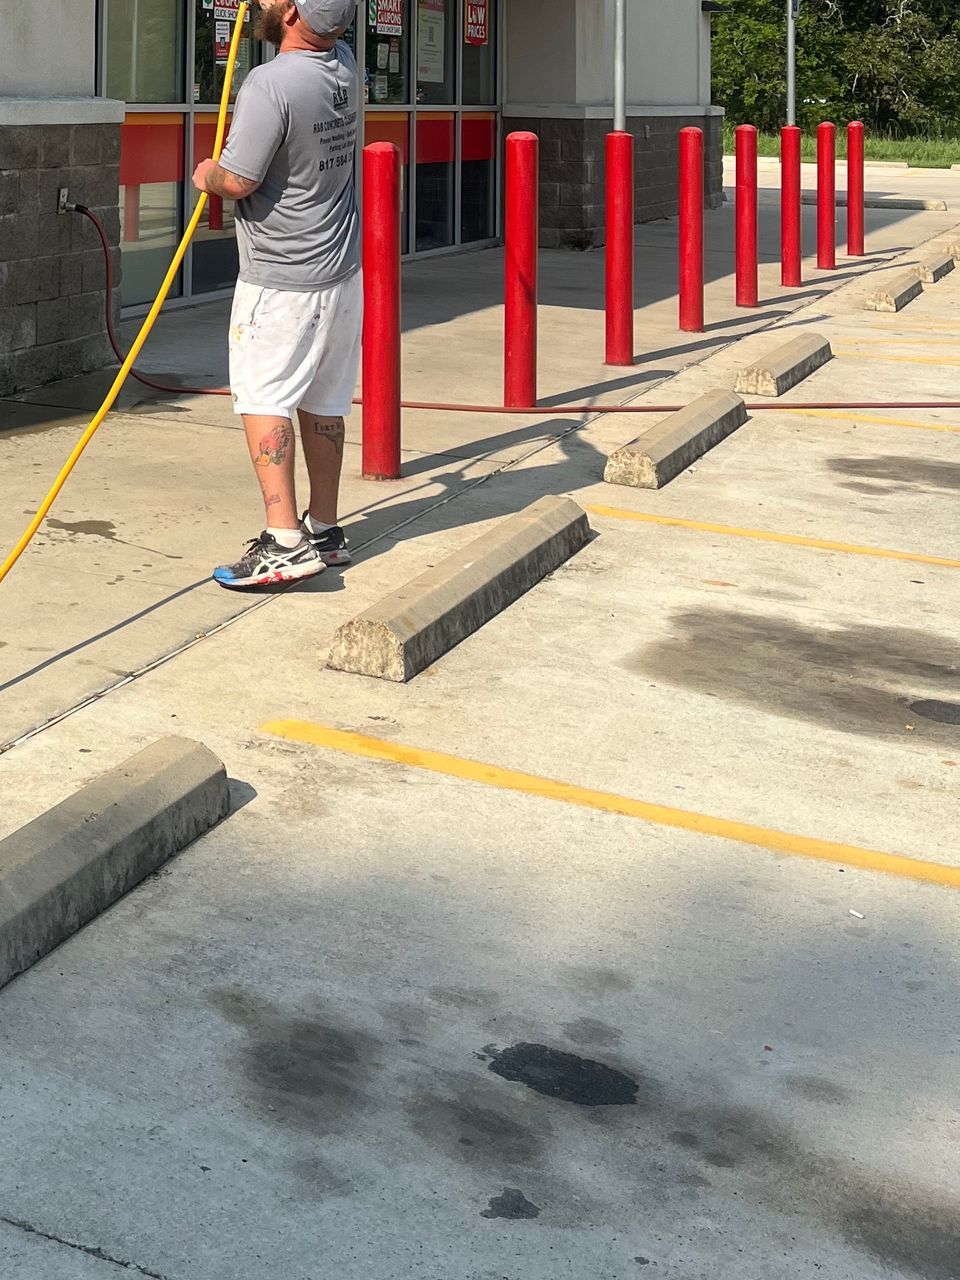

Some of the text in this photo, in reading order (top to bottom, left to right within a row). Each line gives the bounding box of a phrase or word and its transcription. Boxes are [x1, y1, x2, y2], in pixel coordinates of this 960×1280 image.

[378, 11, 402, 25] COUPONS
[468, 5, 485, 25] LOW
[468, 25, 485, 38] PRICES
[319, 158, 334, 172] 817
